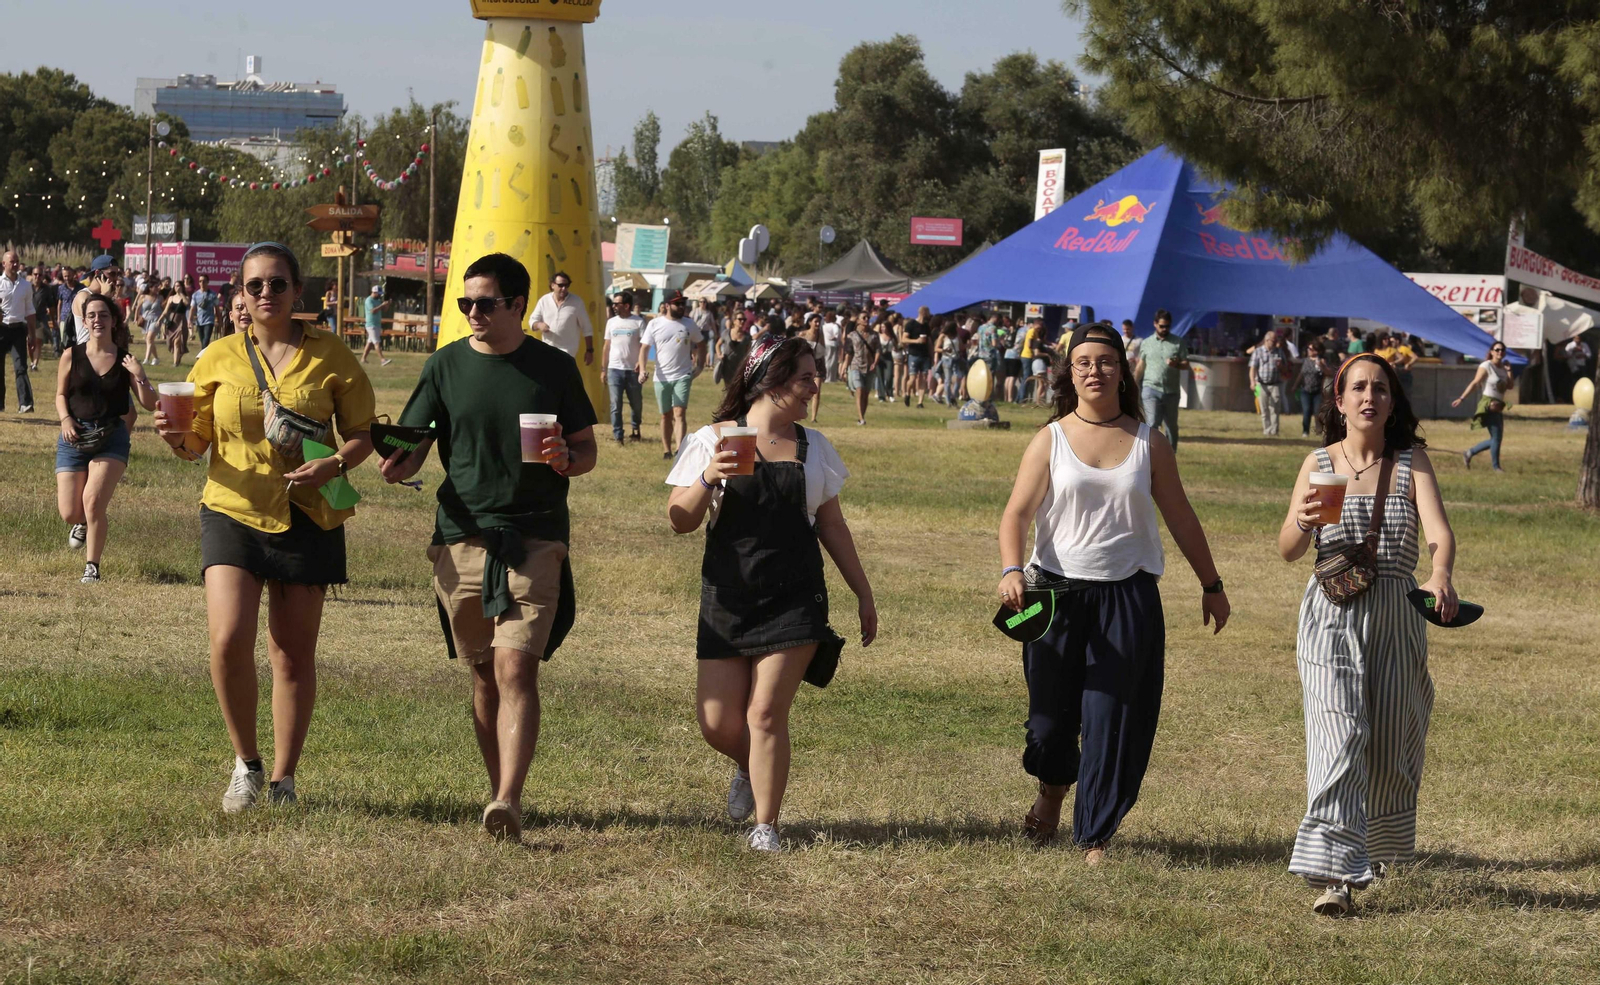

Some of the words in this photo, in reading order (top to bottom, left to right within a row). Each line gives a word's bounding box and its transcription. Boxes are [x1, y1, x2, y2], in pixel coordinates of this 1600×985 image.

[328, 207, 363, 215] SALIDA
[1054, 227, 1105, 252] Red
[1094, 229, 1140, 253] Bull
[1199, 232, 1253, 259] Red
[196, 266, 218, 274] CASH
